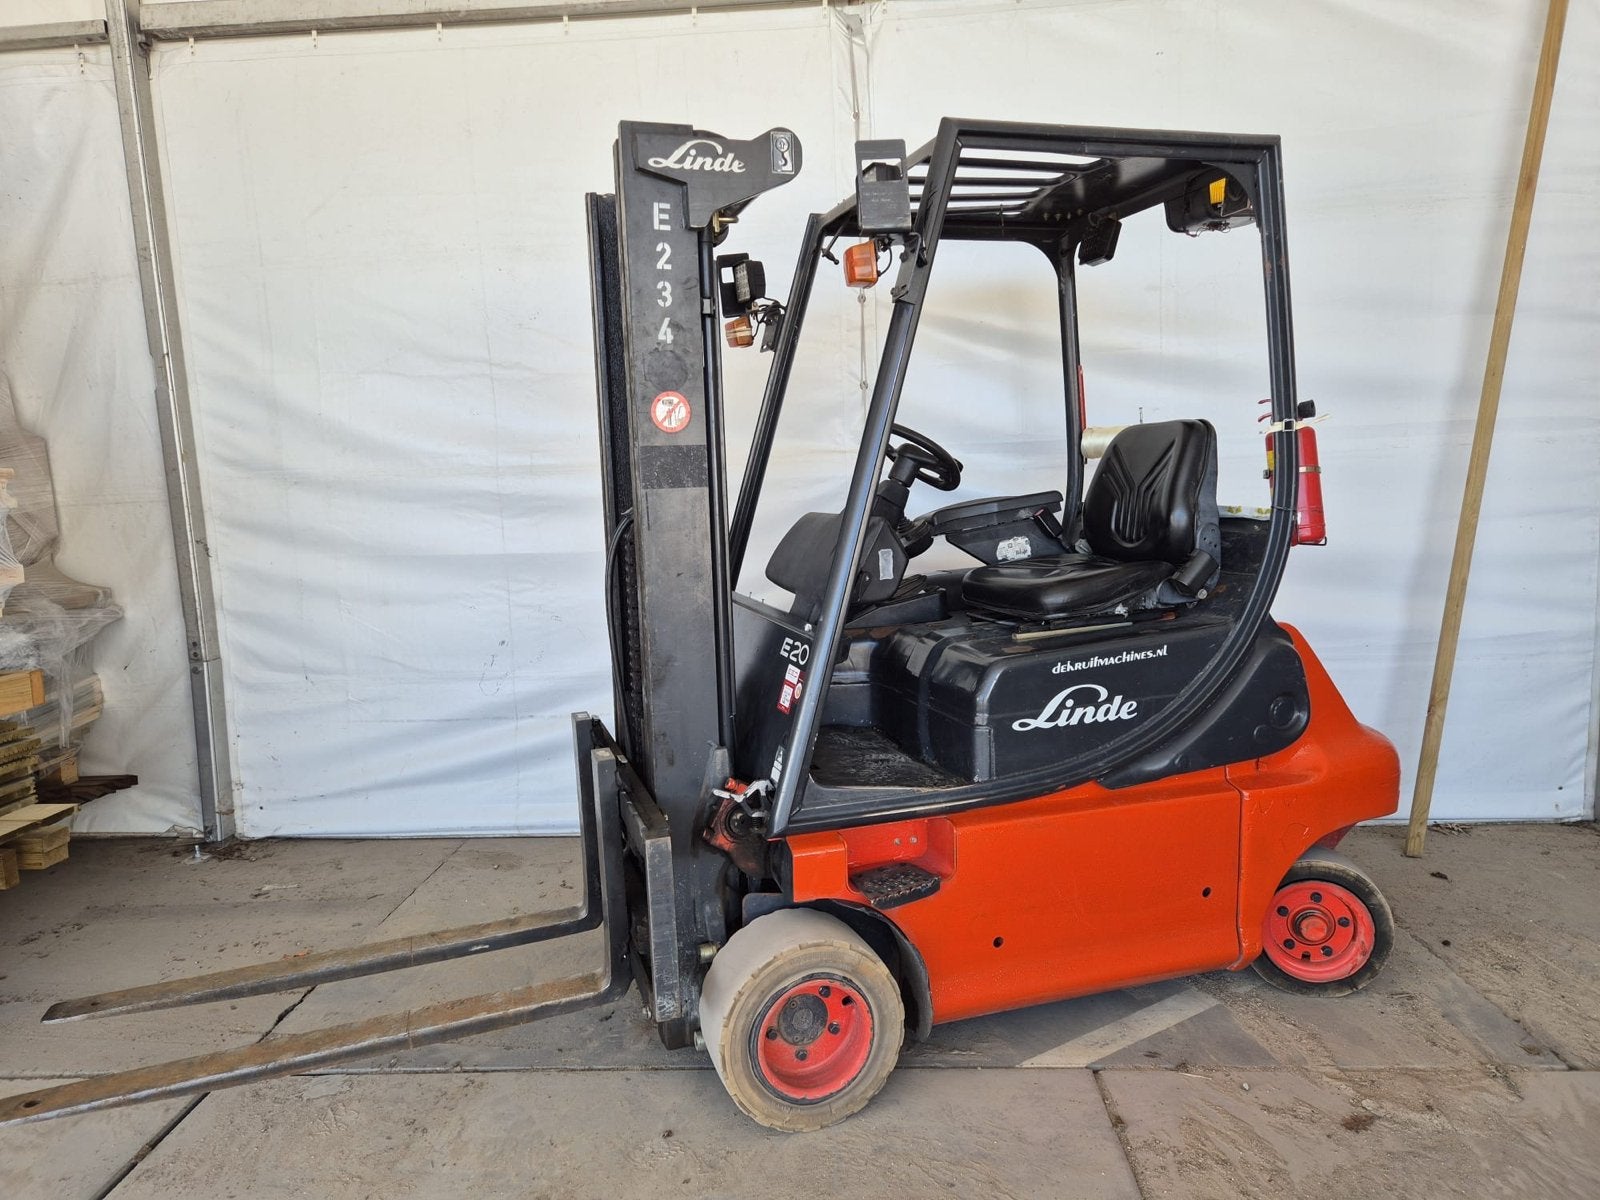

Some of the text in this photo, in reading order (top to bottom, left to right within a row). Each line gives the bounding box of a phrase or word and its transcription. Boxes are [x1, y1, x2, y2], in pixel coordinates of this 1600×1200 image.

[648, 139, 747, 173] Linde
[780, 637, 810, 665] E20
[1011, 683, 1138, 732] Linde
